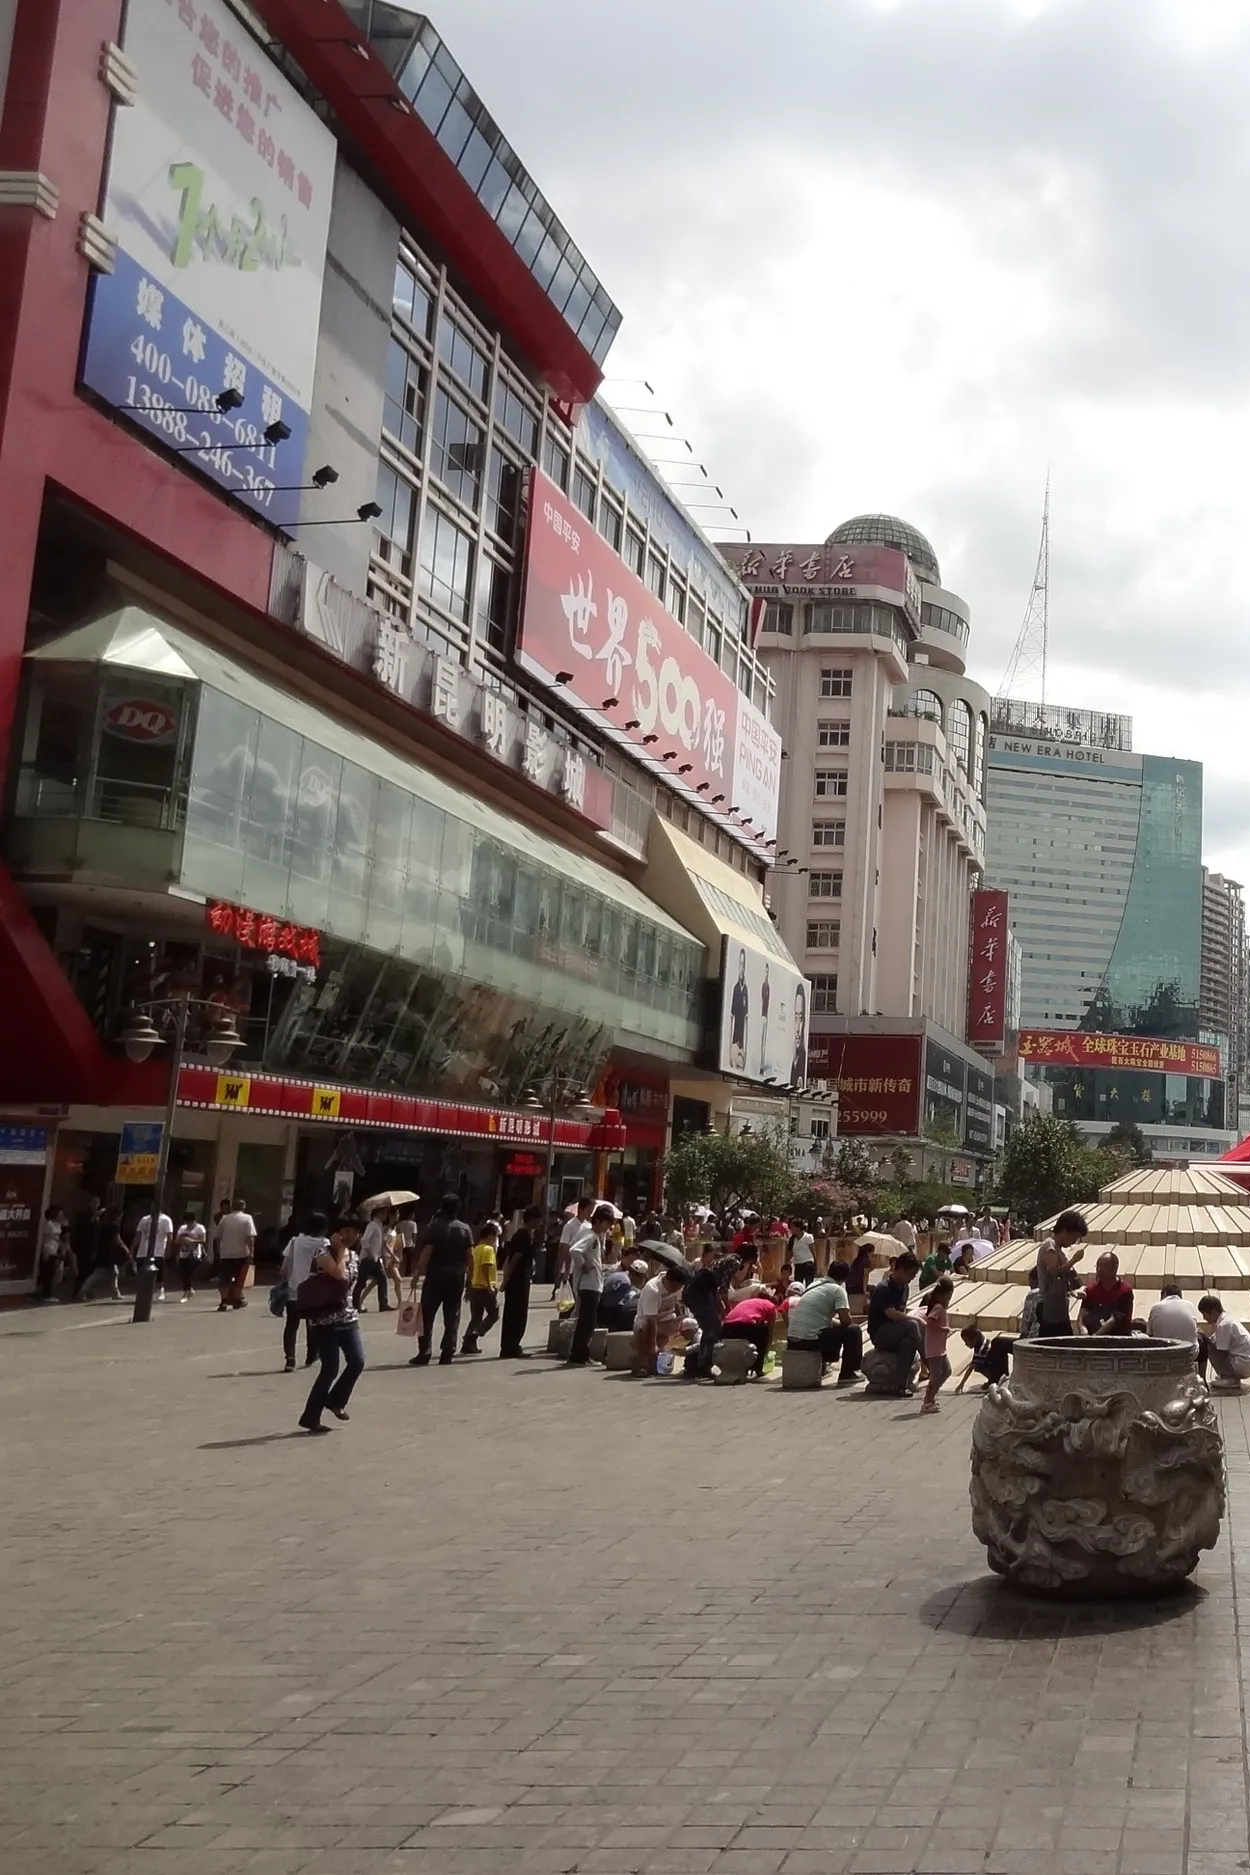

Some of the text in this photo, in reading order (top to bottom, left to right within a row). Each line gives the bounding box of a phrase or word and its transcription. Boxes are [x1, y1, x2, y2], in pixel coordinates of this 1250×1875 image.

[125, 375, 277, 507] 13888-246-367
[543, 502, 582, 555] 中国平安
[118, 707, 167, 735] DQ
[373, 617, 587, 808] 新昆明影城
[741, 711, 778, 766] 中国平安
[1004, 741, 1105, 763] NEW ERA HOTEL
[1082, 1035, 1187, 1062] 全球珠宝玉石产业基地
